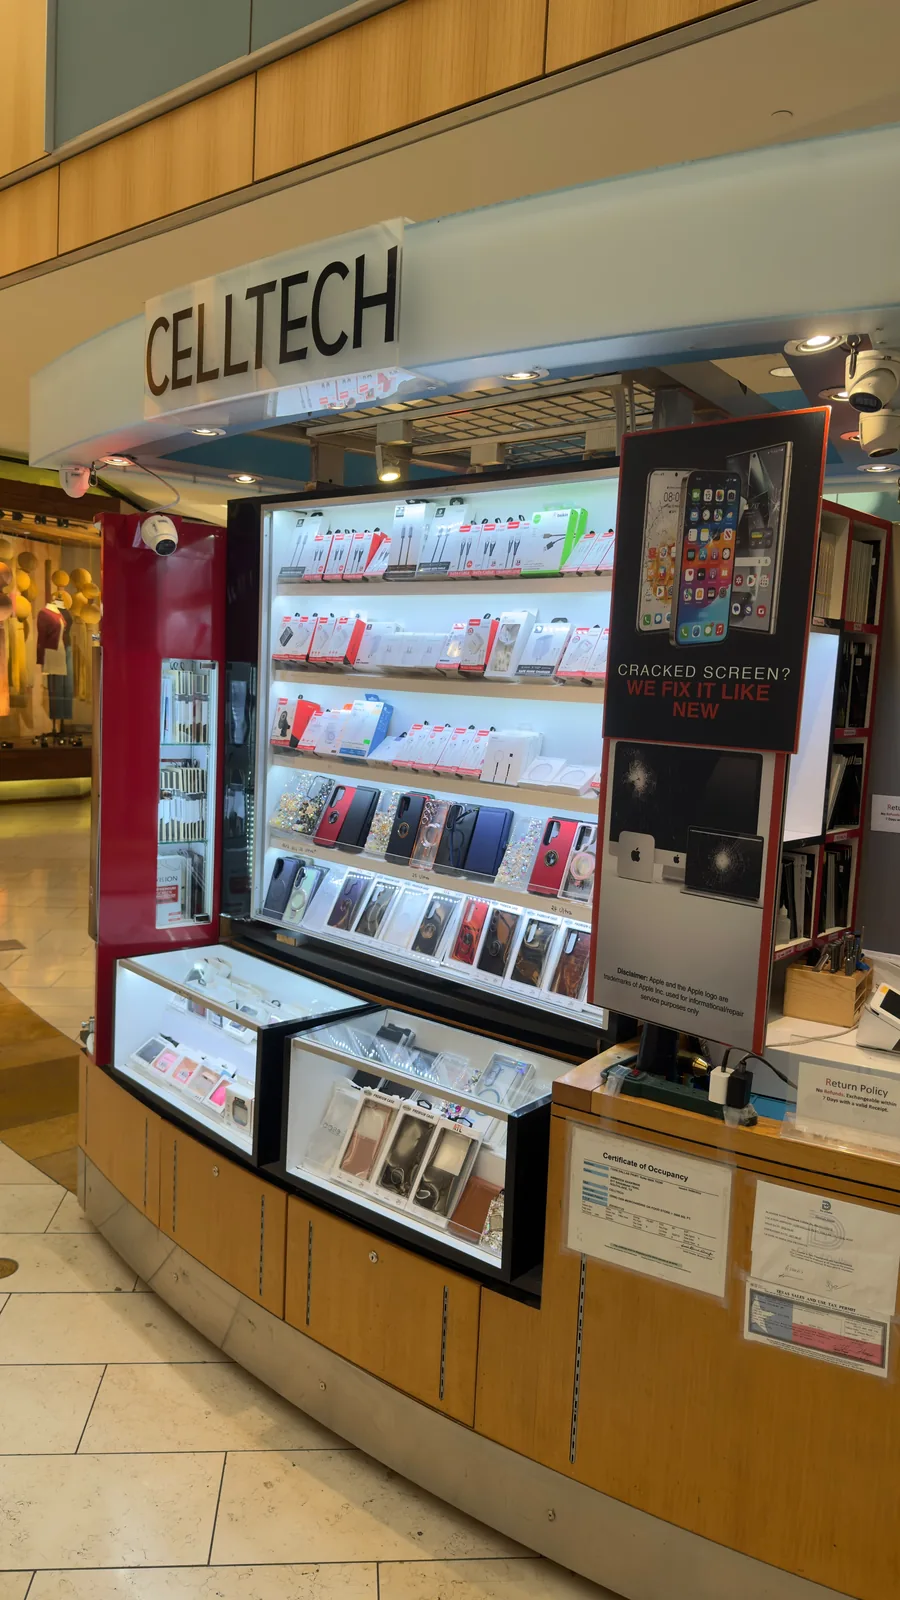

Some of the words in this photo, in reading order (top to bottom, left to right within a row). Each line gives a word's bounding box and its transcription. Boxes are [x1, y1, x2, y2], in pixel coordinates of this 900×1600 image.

[146, 245, 398, 397] CELLTECH
[618, 664, 696, 678] CRACKED
[703, 665, 791, 681] SCREEN?
[627, 680, 656, 696] WE
[662, 681, 691, 698] FIX
[696, 682, 716, 699] IT
[721, 683, 770, 702] LIKE
[672, 701, 720, 719] NEW
[603, 973, 632, 987] trademarks
[638, 982, 654, 994] Apple
[654, 986, 664, 995] Inc.
[665, 991, 680, 1000] used
[680, 993, 688, 1001] for
[688, 995, 744, 1018] informational/repair
[617, 967, 648, 981] Disclaimer:
[649, 976, 665, 986] Apple
[665, 980, 676, 989] and
[677, 983, 686, 991] the
[687, 986, 704, 997] Apple
[704, 990, 718, 1002] logo
[718, 994, 729, 1003] are
[640, 993, 660, 1004] service
[660, 999, 686, 1013] purposes
[687, 1005, 700, 1017] only
[825, 1078, 858, 1091] Return
[860, 1084, 889, 1098] Policy
[846, 1093, 880, 1104] Exchangeable
[881, 1098, 897, 1107] within
[868, 1104, 889, 1113] Receipt.
[602, 1152, 638, 1168] Certificate
[639, 1161, 647, 1170] of
[648, 1164, 689, 1182] Occupancy
